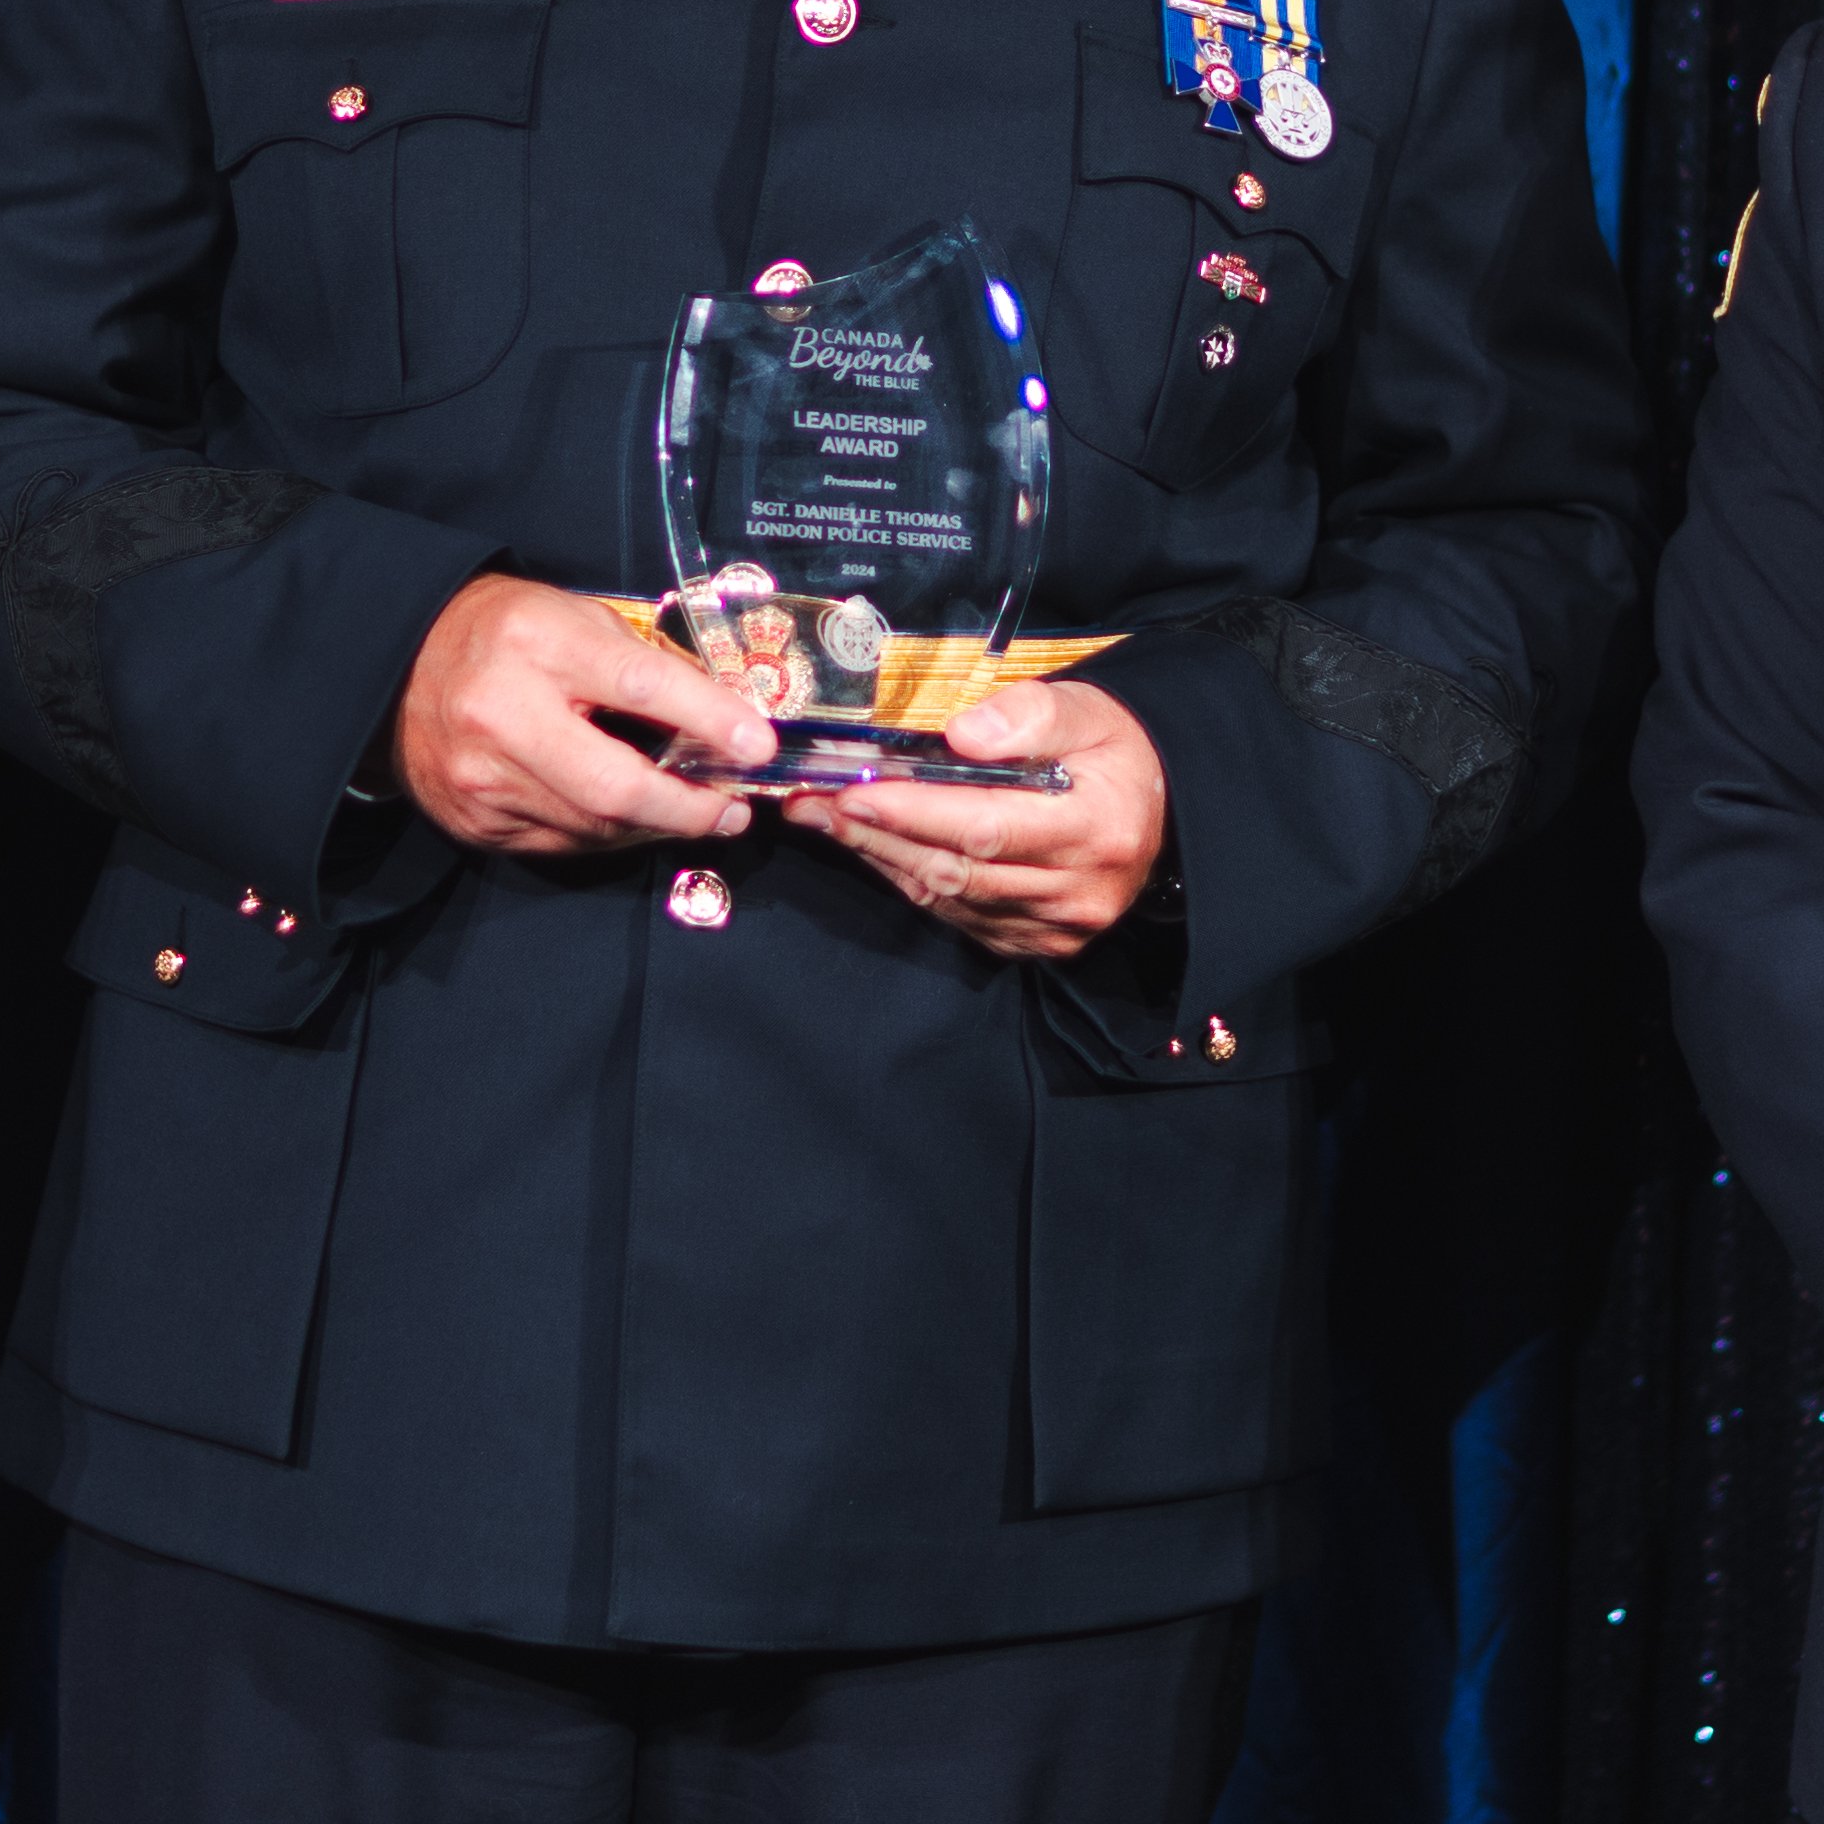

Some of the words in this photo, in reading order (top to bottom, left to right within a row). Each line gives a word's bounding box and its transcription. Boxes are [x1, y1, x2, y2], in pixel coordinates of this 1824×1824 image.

[821, 328, 903, 349] CANADA
[789, 326, 925, 381] Beyond
[853, 374, 881, 388] THE
[883, 377, 921, 391] BLUE
[793, 411, 927, 436] LEADERSHIP
[820, 436, 899, 458] AWARD
[823, 475, 882, 489] Presented
[884, 480, 897, 490] to
[750, 501, 790, 518] SGT.
[794, 504, 882, 524] DANIELLE
[885, 510, 963, 529] THOMAS
[745, 521, 824, 540] LONDON
[827, 527, 893, 545] POLICE
[896, 532, 973, 551] SERVICE
[841, 563, 876, 577] 2024
